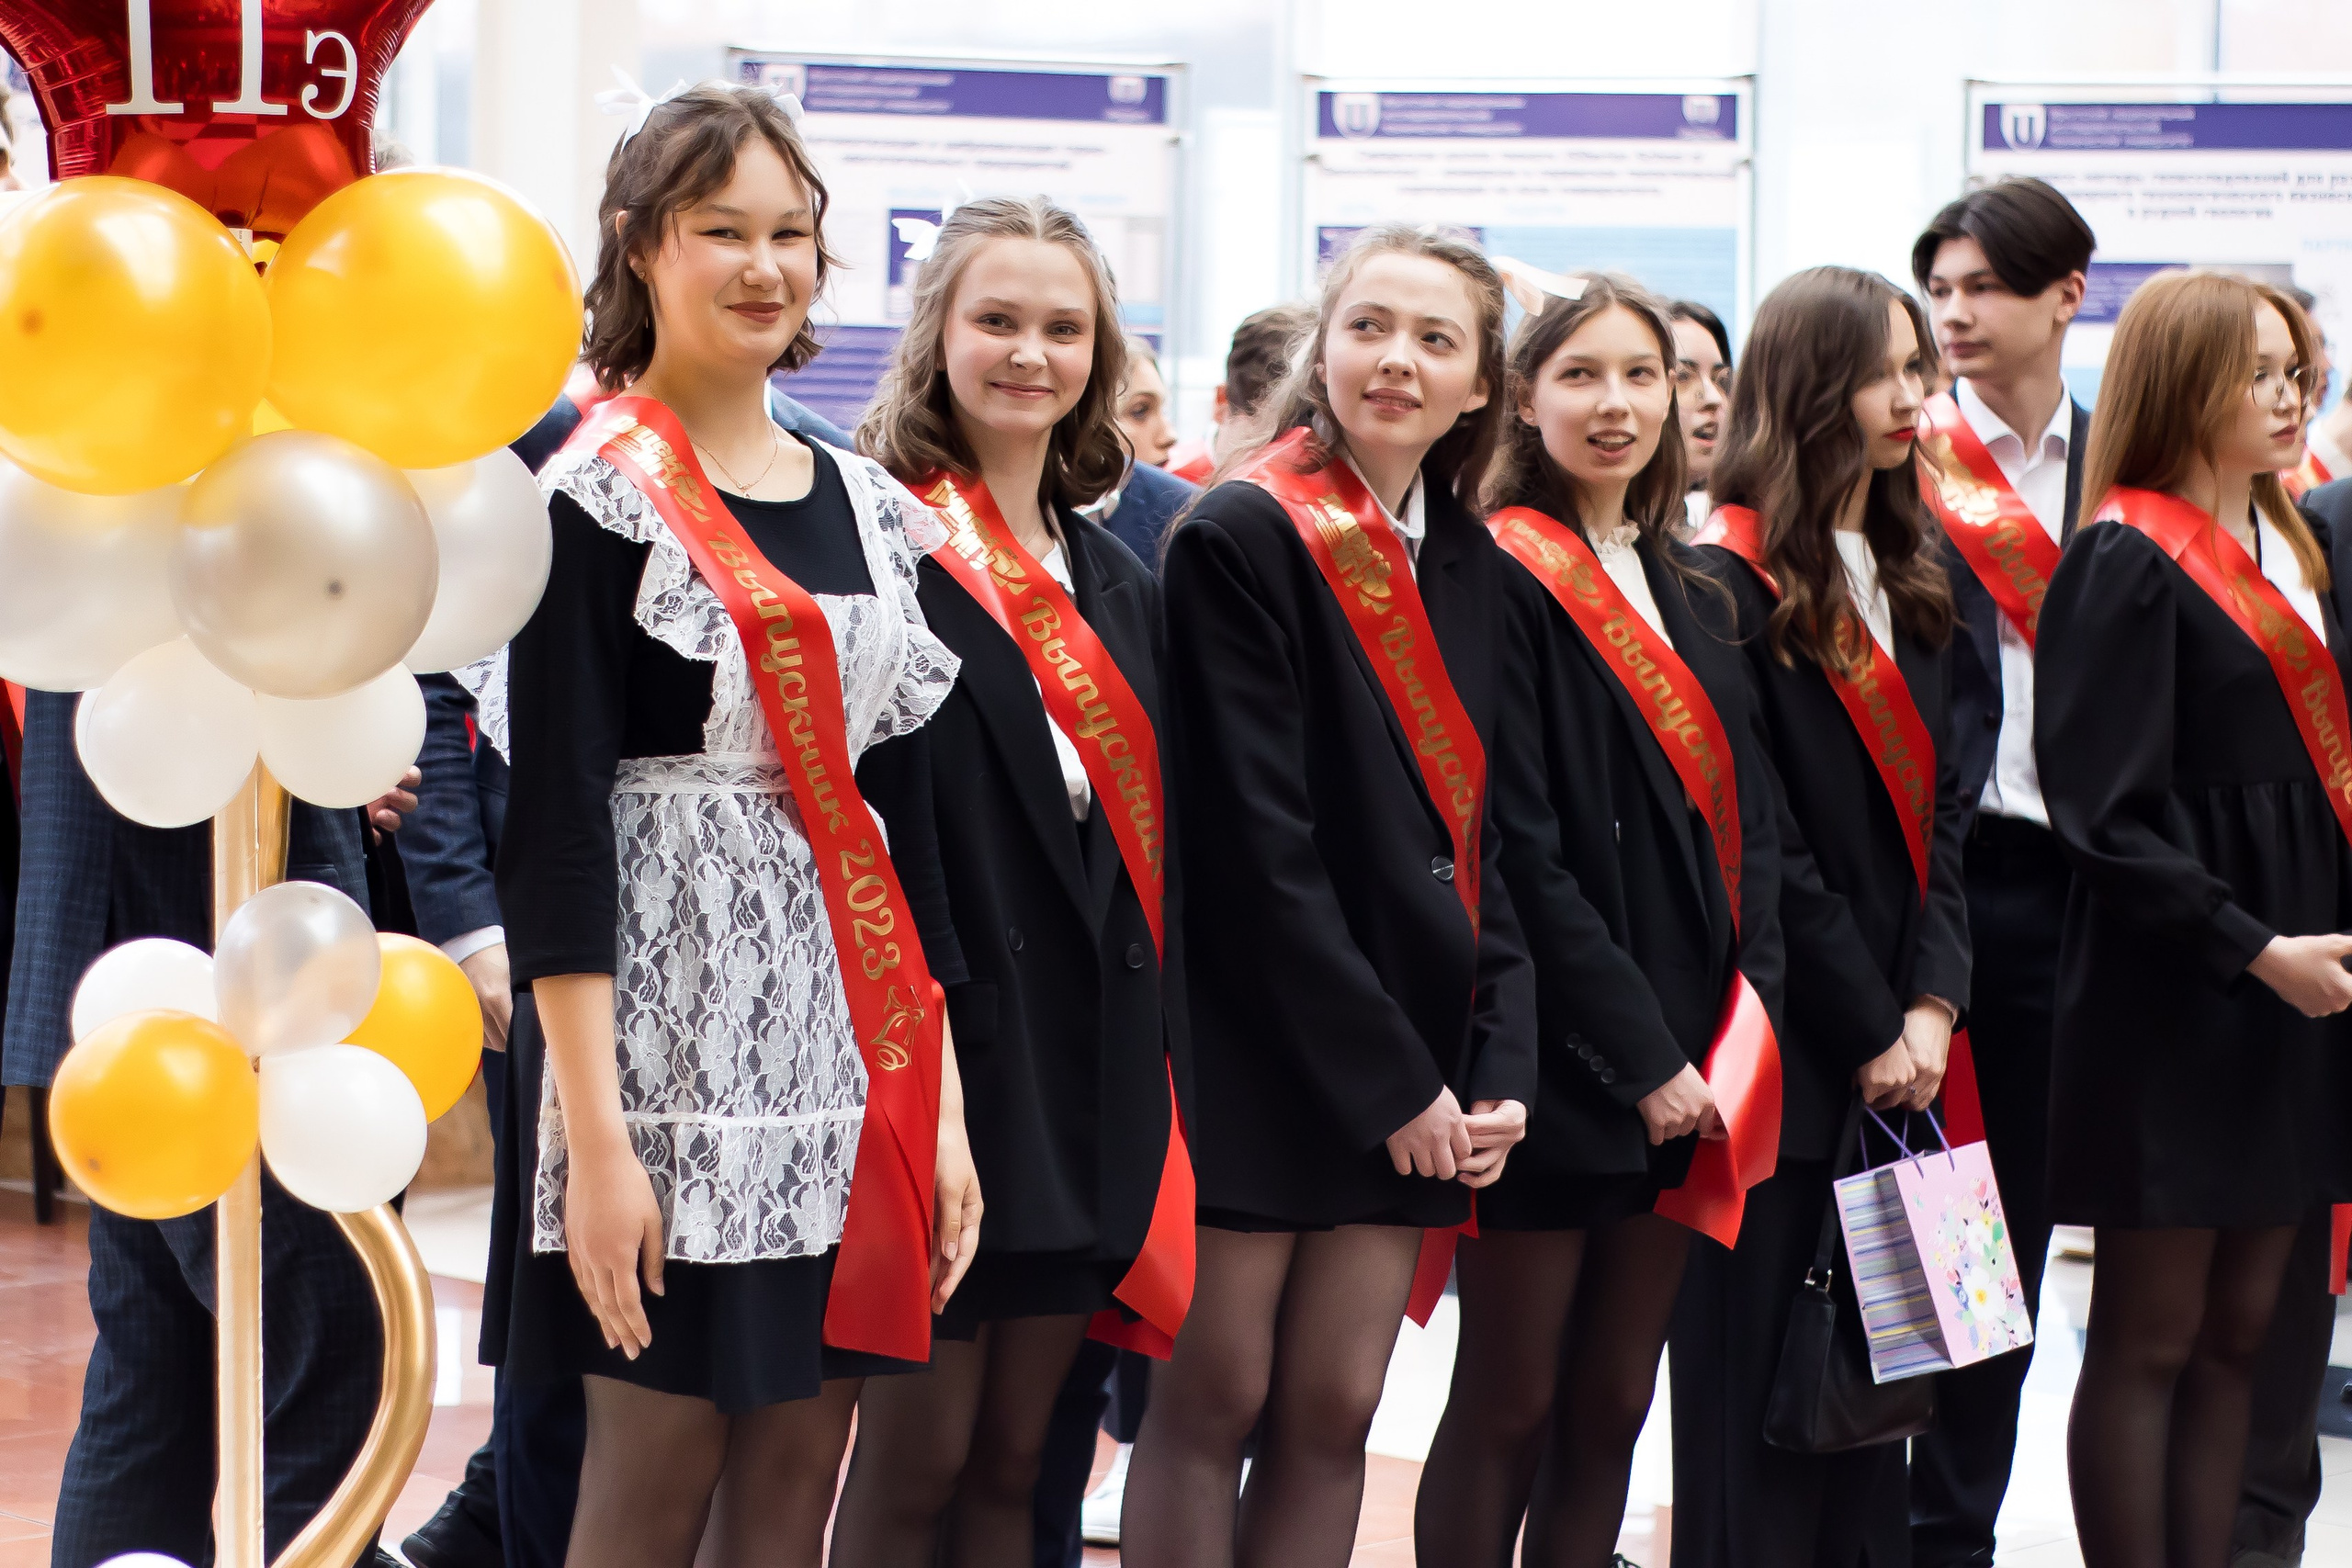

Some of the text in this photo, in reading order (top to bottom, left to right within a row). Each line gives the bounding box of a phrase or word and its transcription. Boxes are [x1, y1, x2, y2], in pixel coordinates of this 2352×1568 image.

[1984, 519, 2050, 631] Вып
[707, 530, 901, 981] Выпускник 2023
[1020, 594, 1163, 880] Выпускник
